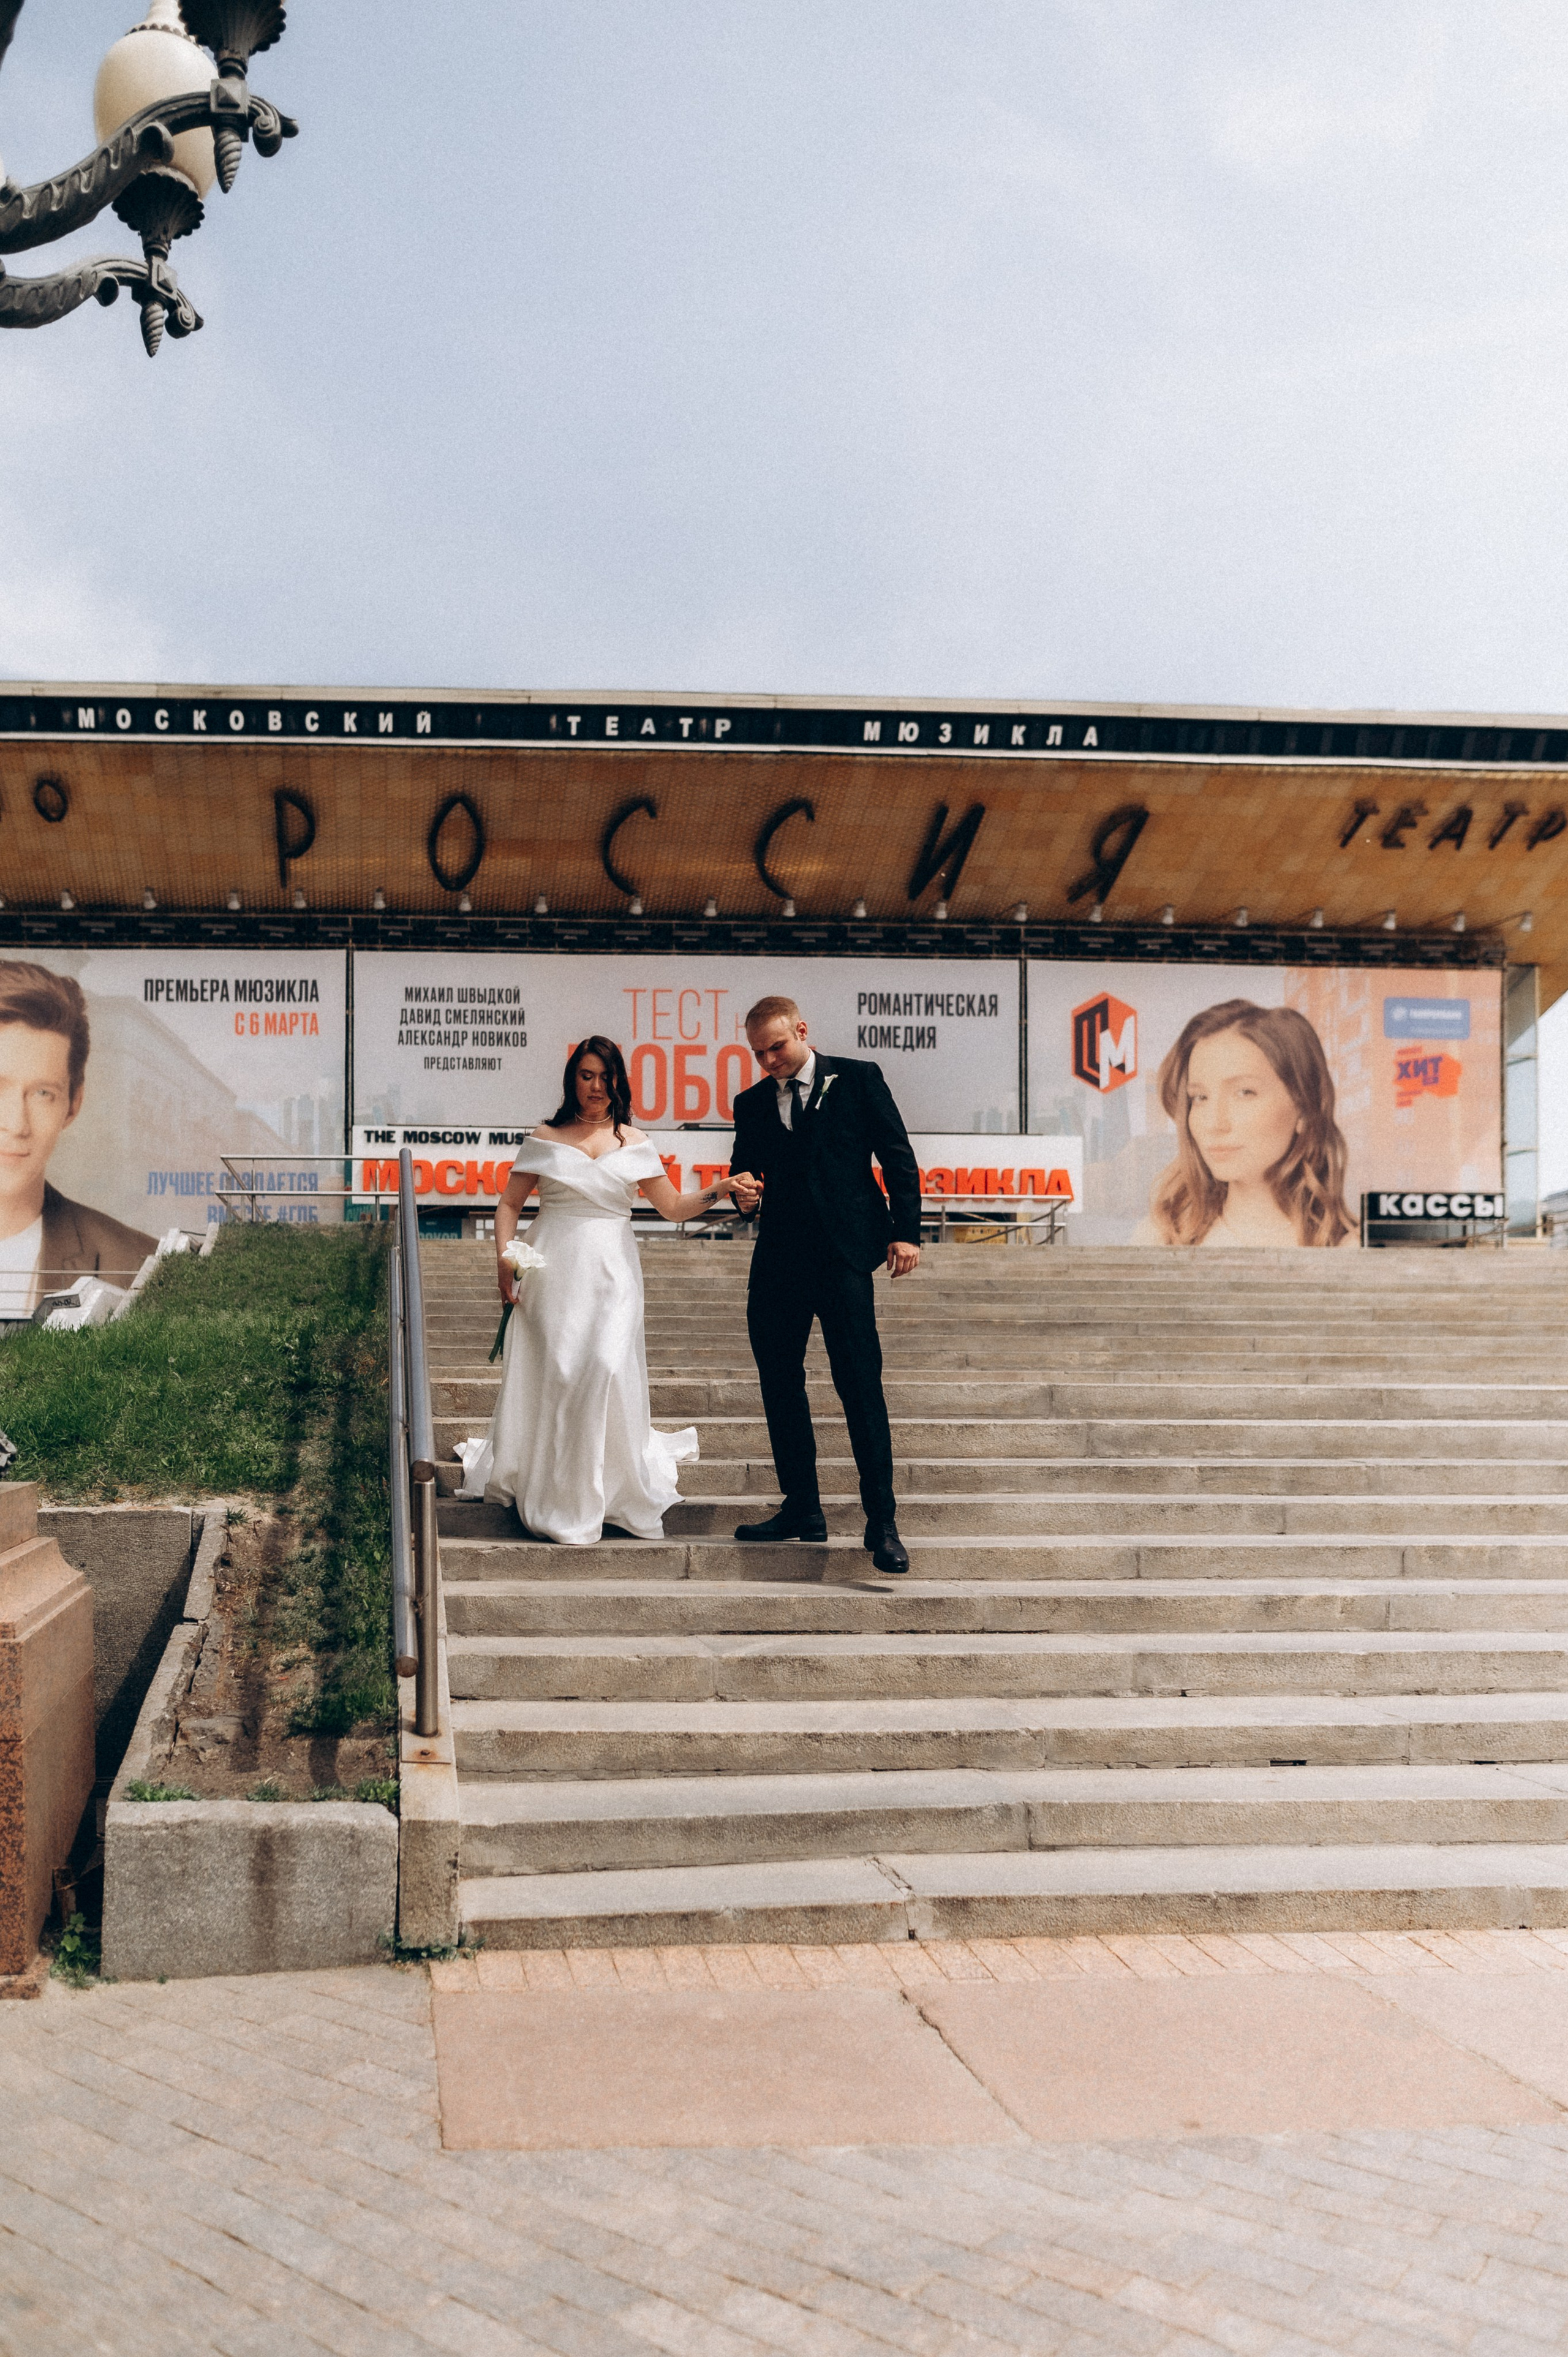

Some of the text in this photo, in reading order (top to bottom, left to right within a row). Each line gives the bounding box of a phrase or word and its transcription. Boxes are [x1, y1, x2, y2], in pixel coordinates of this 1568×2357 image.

[77, 707, 1098, 747] МОСКОВСКИЙ ТЕАТР МЮЗИКЛА
[1340, 799, 1568, 851] ТЕАТР
[274, 789, 1150, 905] РОССИЯ
[144, 979, 319, 1003] ПРЕМЬЕРА МЮЗИКЛА
[405, 986, 520, 1005] МИХАИЛ ШВЫДКОЙ
[623, 989, 729, 1041] ТЕСТ
[858, 992, 998, 1017] РОМАНТИЧЕСКАЯ
[235, 1012, 318, 1035] С 6 МАРТА
[400, 1008, 525, 1026] ДАВИД СМЕЛЯНСКИЙ
[398, 1030, 527, 1047] АЛЕКСАНДР НОВИКОВ
[858, 1025, 937, 1052] КОМЕДИЯ
[424, 1057, 502, 1071] ПРЕДСТАВЛЯЮТ
[364, 1130, 396, 1143] THE
[403, 1131, 481, 1144] MOSCOW
[147, 1172, 214, 1196] ЛУЧШЕЕ
[872, 1167, 1074, 1202] ЗИКЛА
